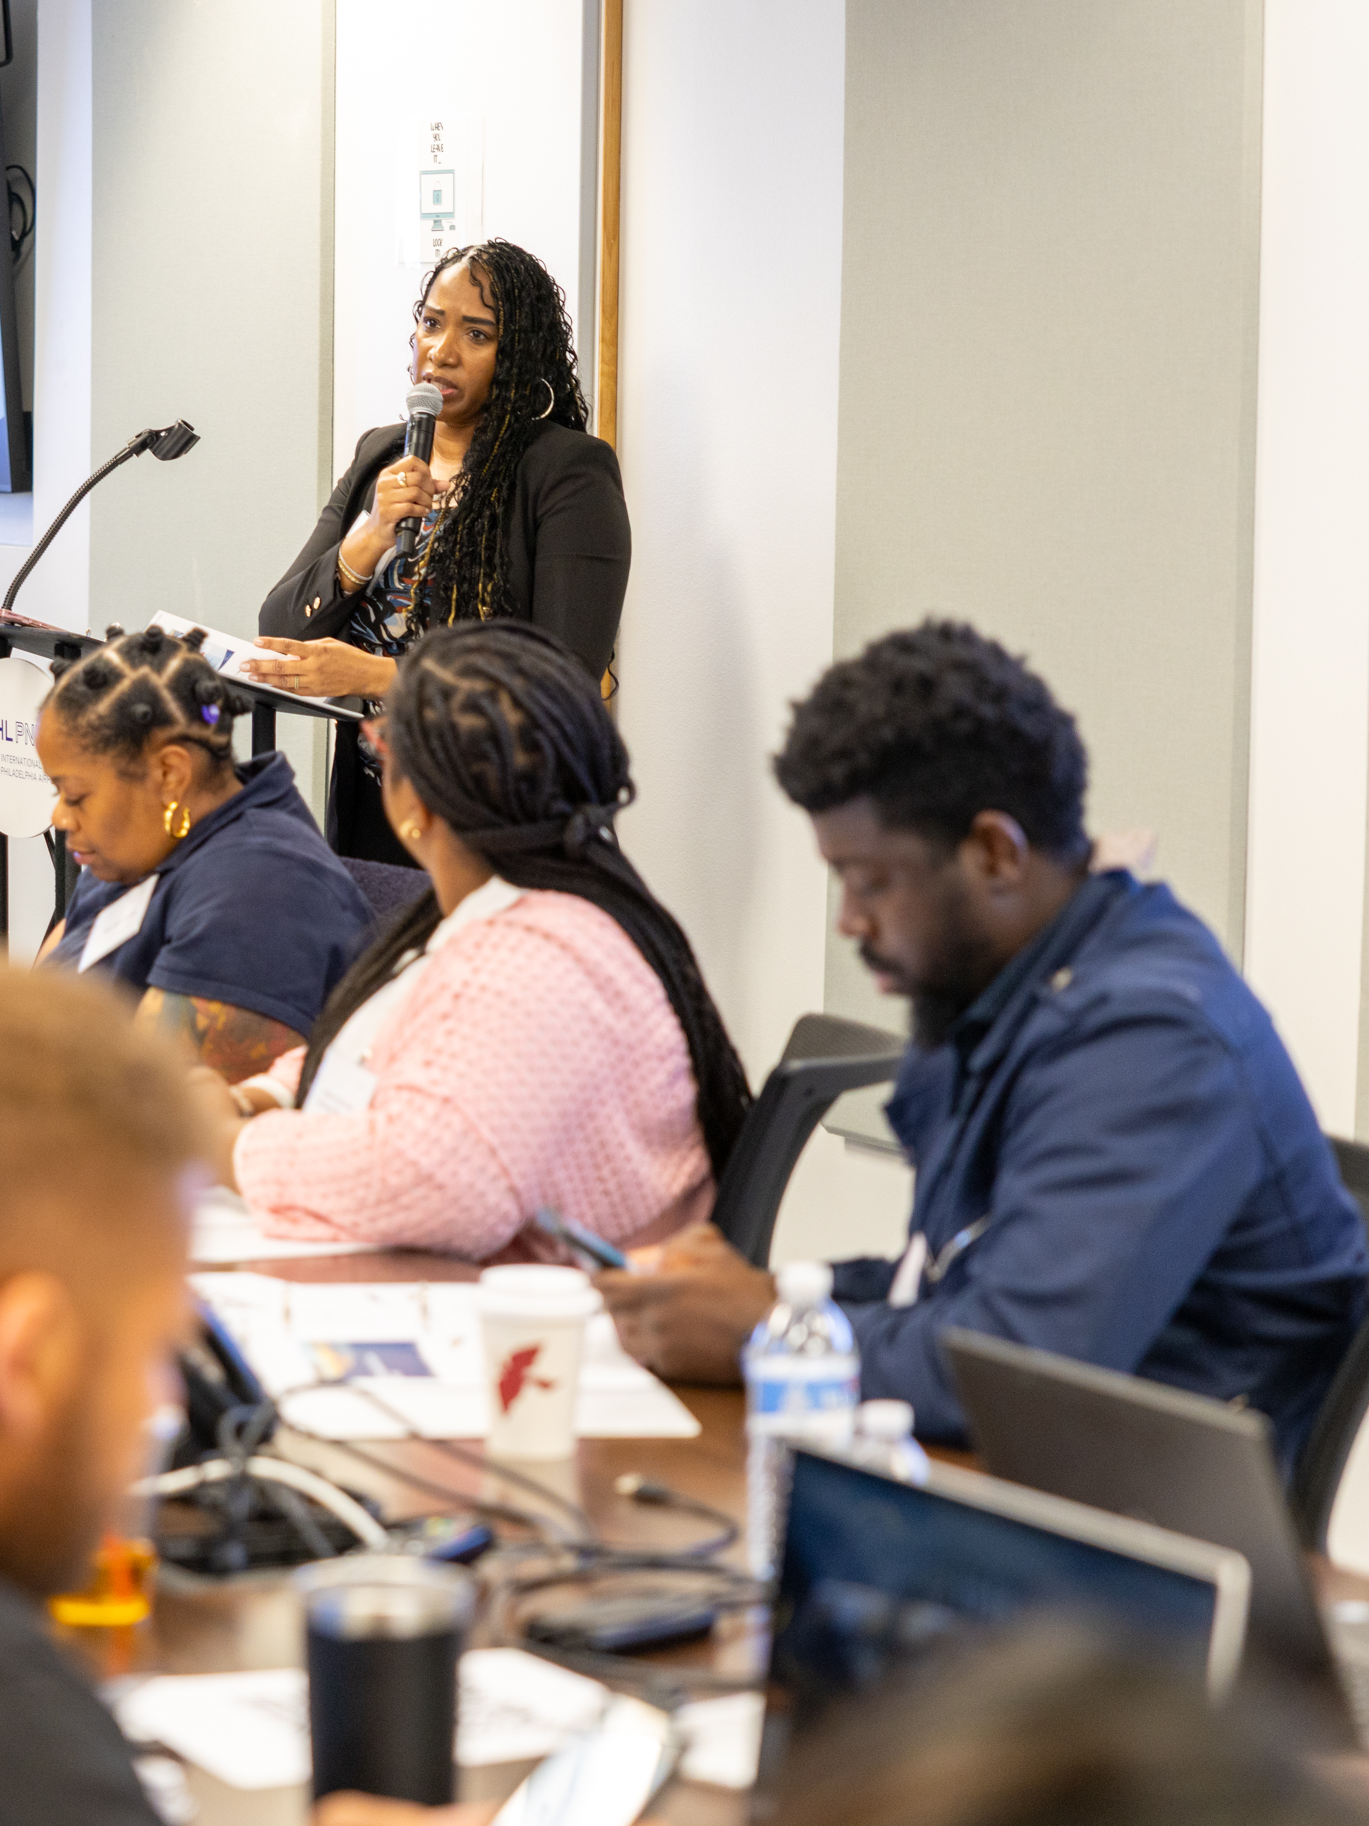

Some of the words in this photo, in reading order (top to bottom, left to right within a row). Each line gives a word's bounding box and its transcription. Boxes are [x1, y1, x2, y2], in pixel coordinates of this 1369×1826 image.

[15, 721, 35, 747] PN
[1, 753, 42, 770] INTERNATIONAL
[0, 766, 38, 782] PHILADELPHIA
[38, 773, 54, 785] AIRP
